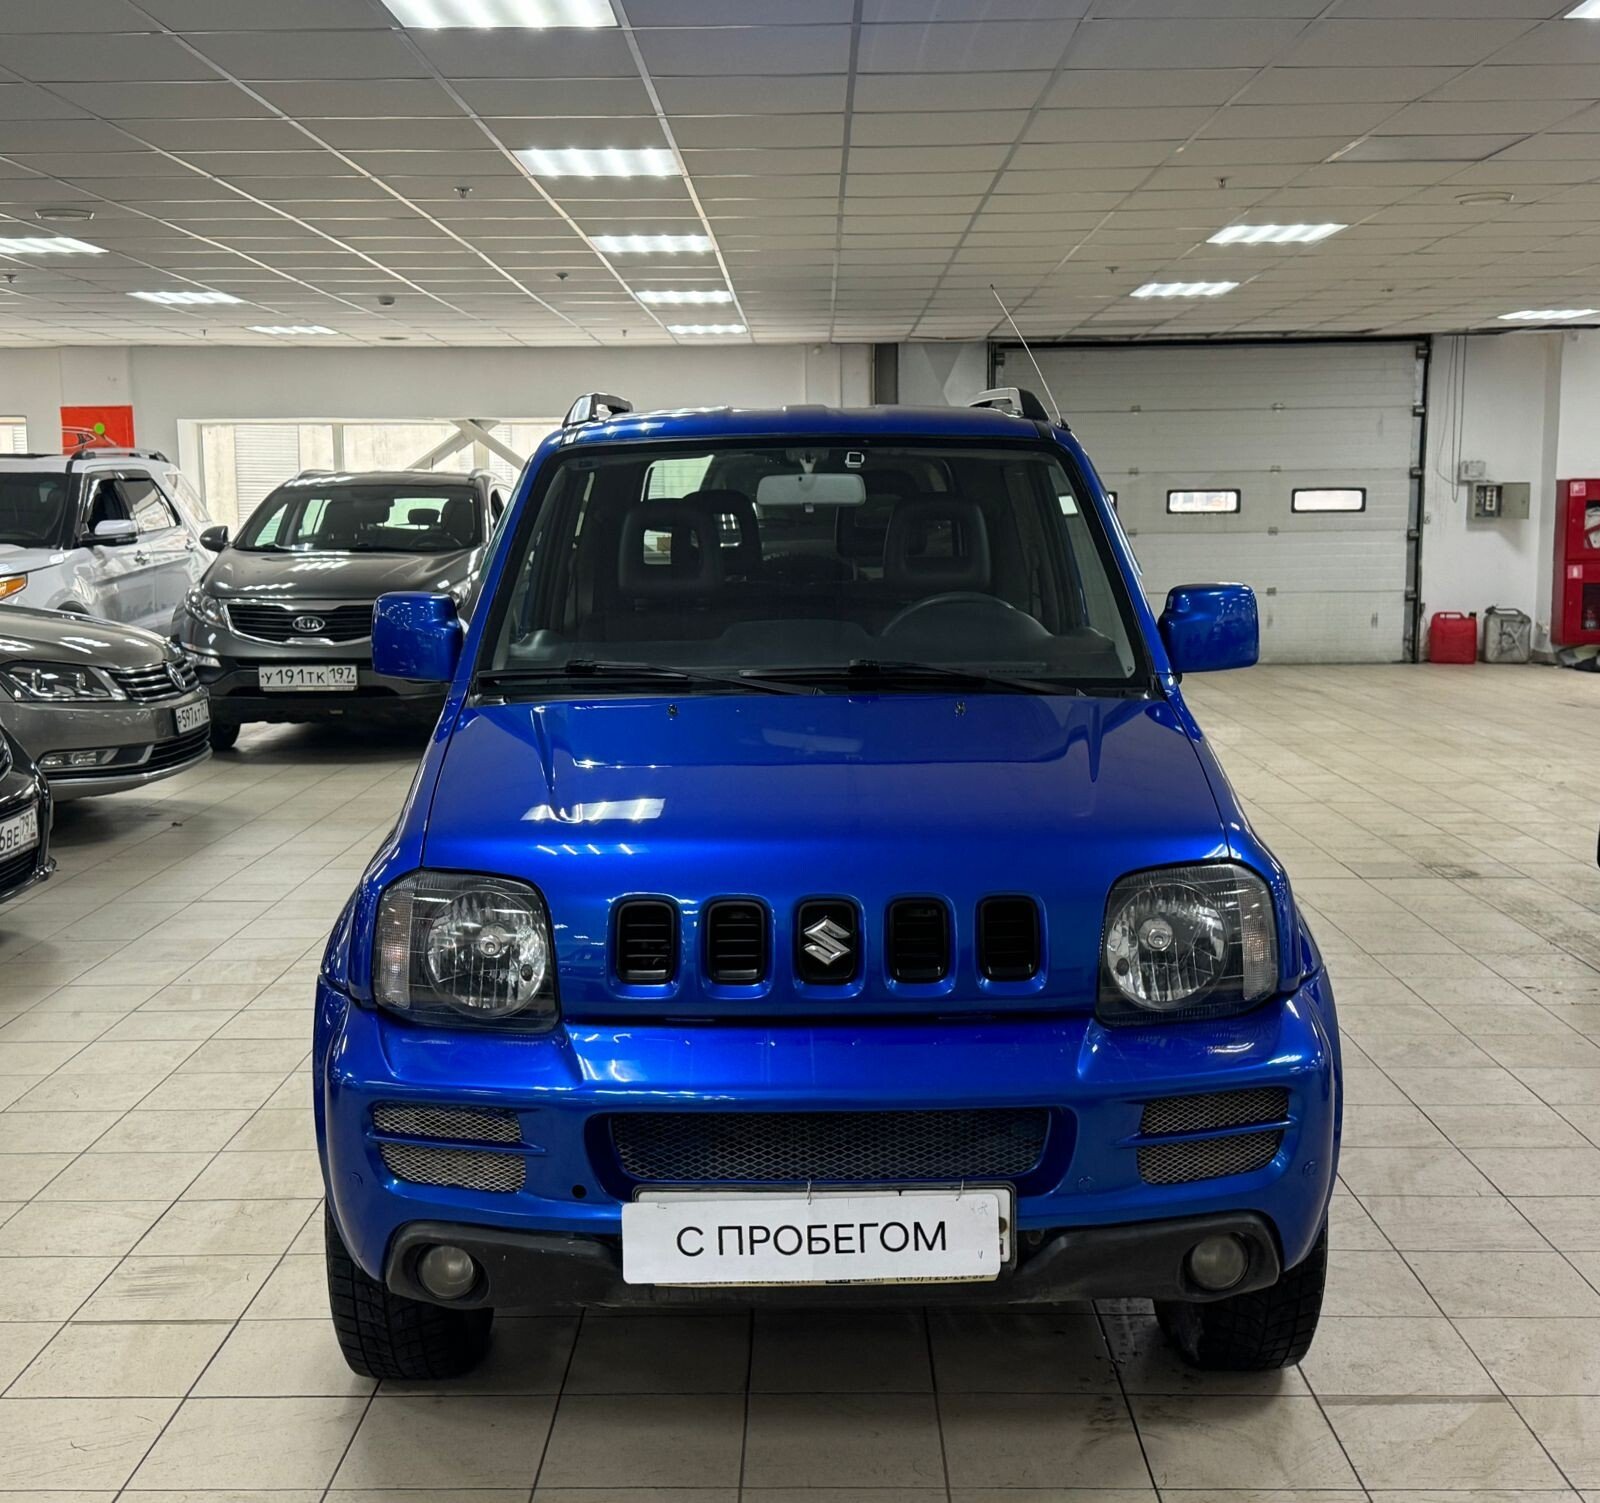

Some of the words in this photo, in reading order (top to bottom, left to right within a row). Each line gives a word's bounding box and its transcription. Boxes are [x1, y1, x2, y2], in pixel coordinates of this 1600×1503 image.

[297, 619, 320, 629] KIA
[328, 667, 352, 680] 197
[676, 1226, 705, 1257] С
[717, 1221, 947, 1256] ПРОБЕГОМ
